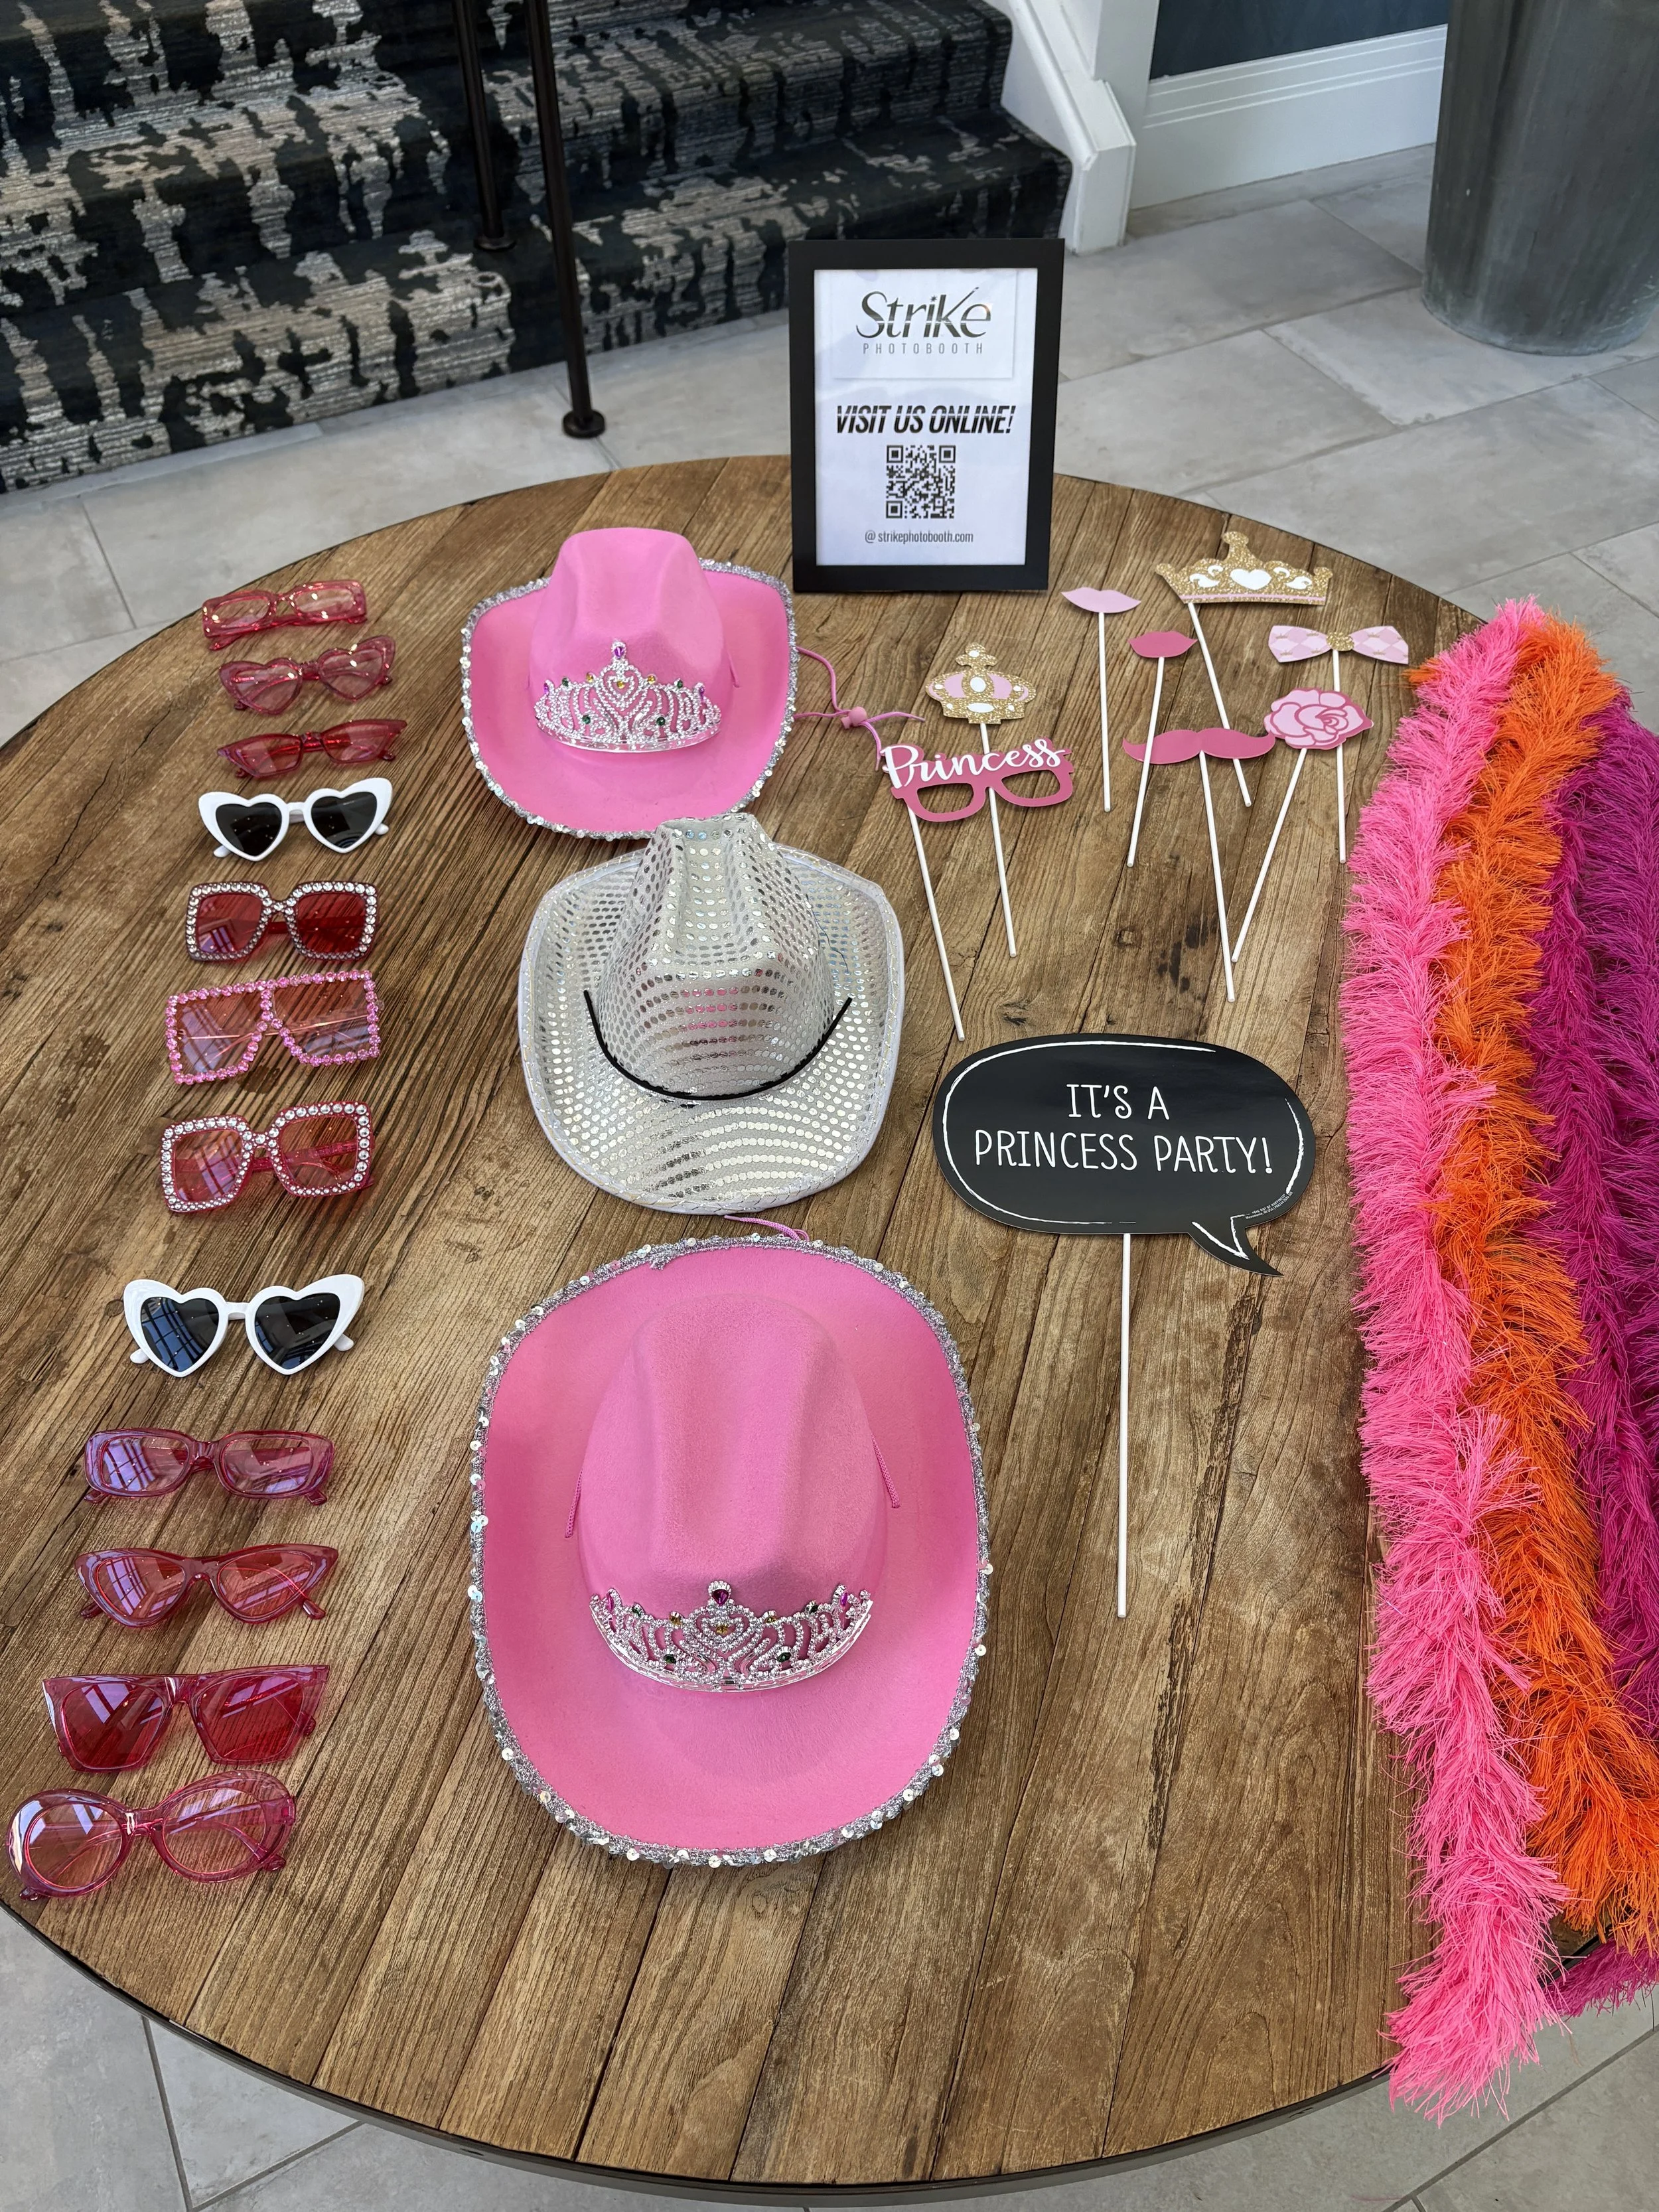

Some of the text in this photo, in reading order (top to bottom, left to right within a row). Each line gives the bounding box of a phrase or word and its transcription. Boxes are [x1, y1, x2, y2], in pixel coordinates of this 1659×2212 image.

[856, 287, 991, 338] Strike
[863, 342, 983, 354] PHOTOBOOTH
[837, 405, 1017, 434] VISIT US ONLINE!
[877, 530, 974, 545] strikephotobooth.com
[880, 739, 1066, 789] Princess
[1066, 1084, 1170, 1120] IT'S A
[975, 1129, 1273, 1175] PRINCESS PARTY!
